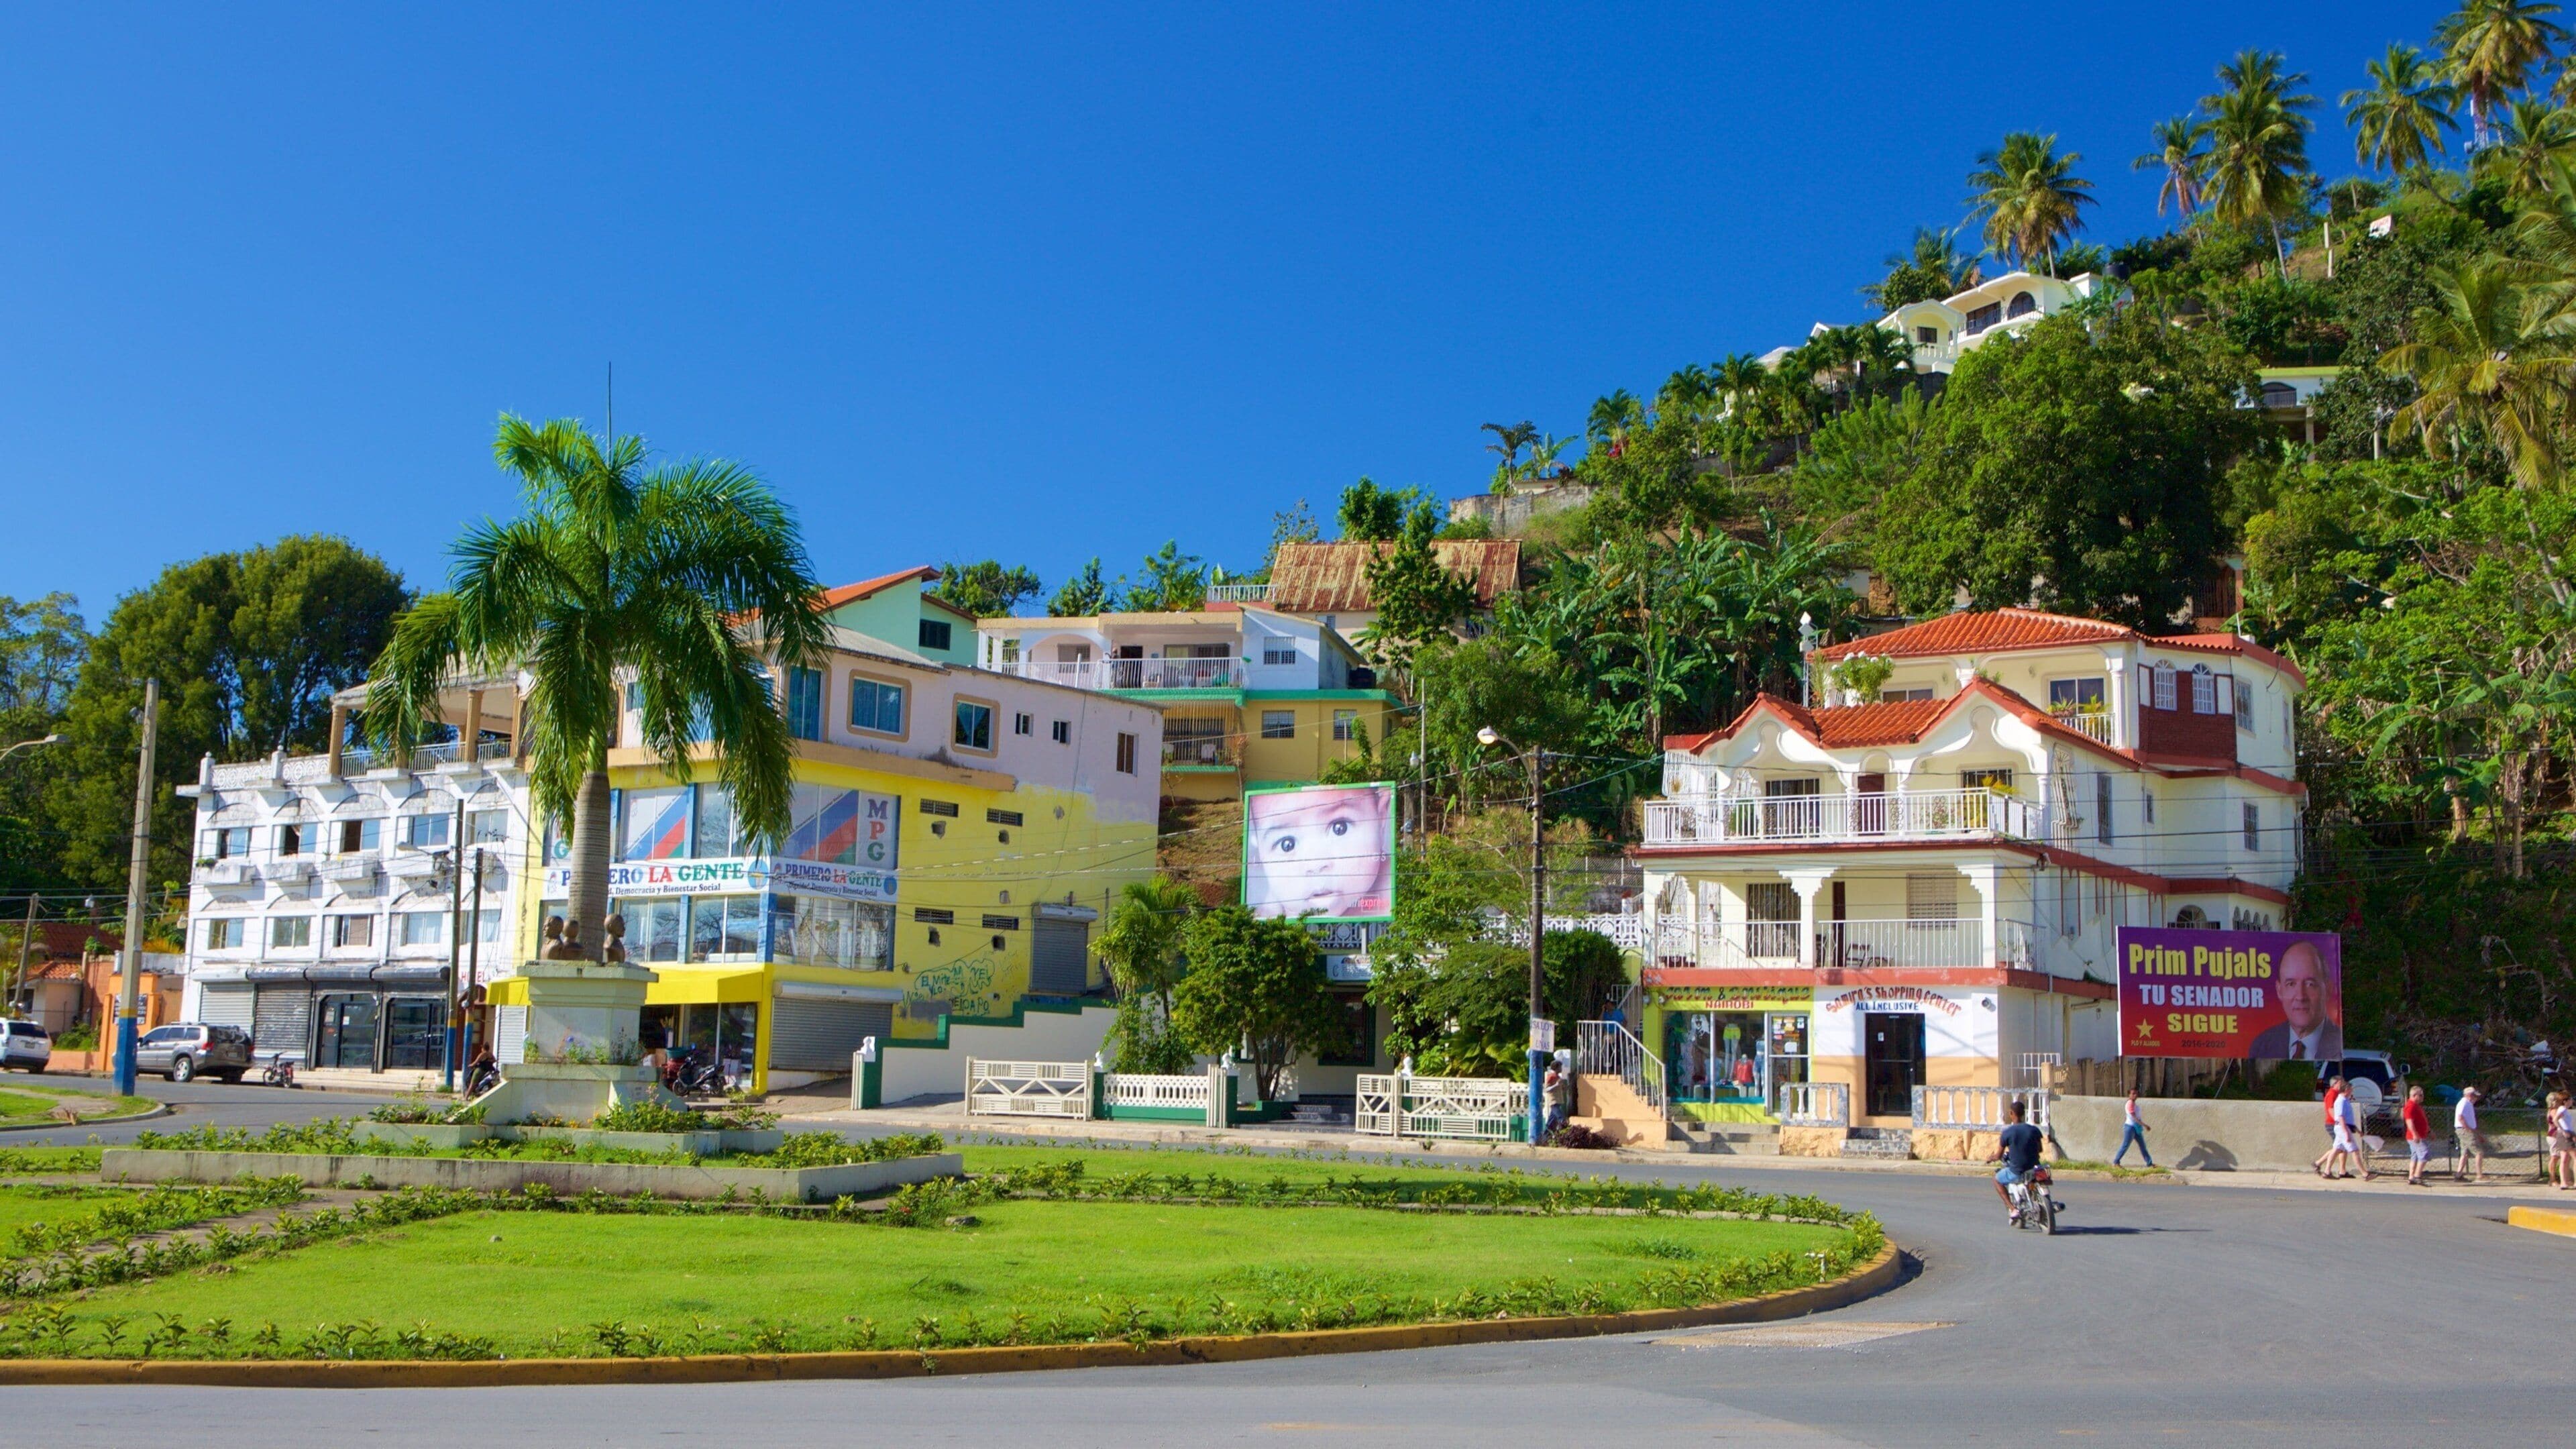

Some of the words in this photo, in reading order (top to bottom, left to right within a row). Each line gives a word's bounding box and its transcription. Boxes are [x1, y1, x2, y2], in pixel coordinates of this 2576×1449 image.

[648, 866, 673, 883] LA
[678, 863, 744, 881] GENTE
[785, 863, 831, 882] PRIMERO
[832, 869, 847, 884] LA
[848, 870, 881, 888] GENTE
[616, 886, 655, 895] Democracia
[663, 884, 698, 893] Bienestar
[699, 883, 721, 892] Social
[2129, 943, 2187, 975] Prim
[2194, 945, 2271, 980] Pujals
[1705, 1000, 1754, 1009] NAIROBI
[2139, 984, 2165, 1006] TU
[2171, 985, 2265, 1008] SENADOR
[2167, 1012, 2239, 1034] SIGUE
